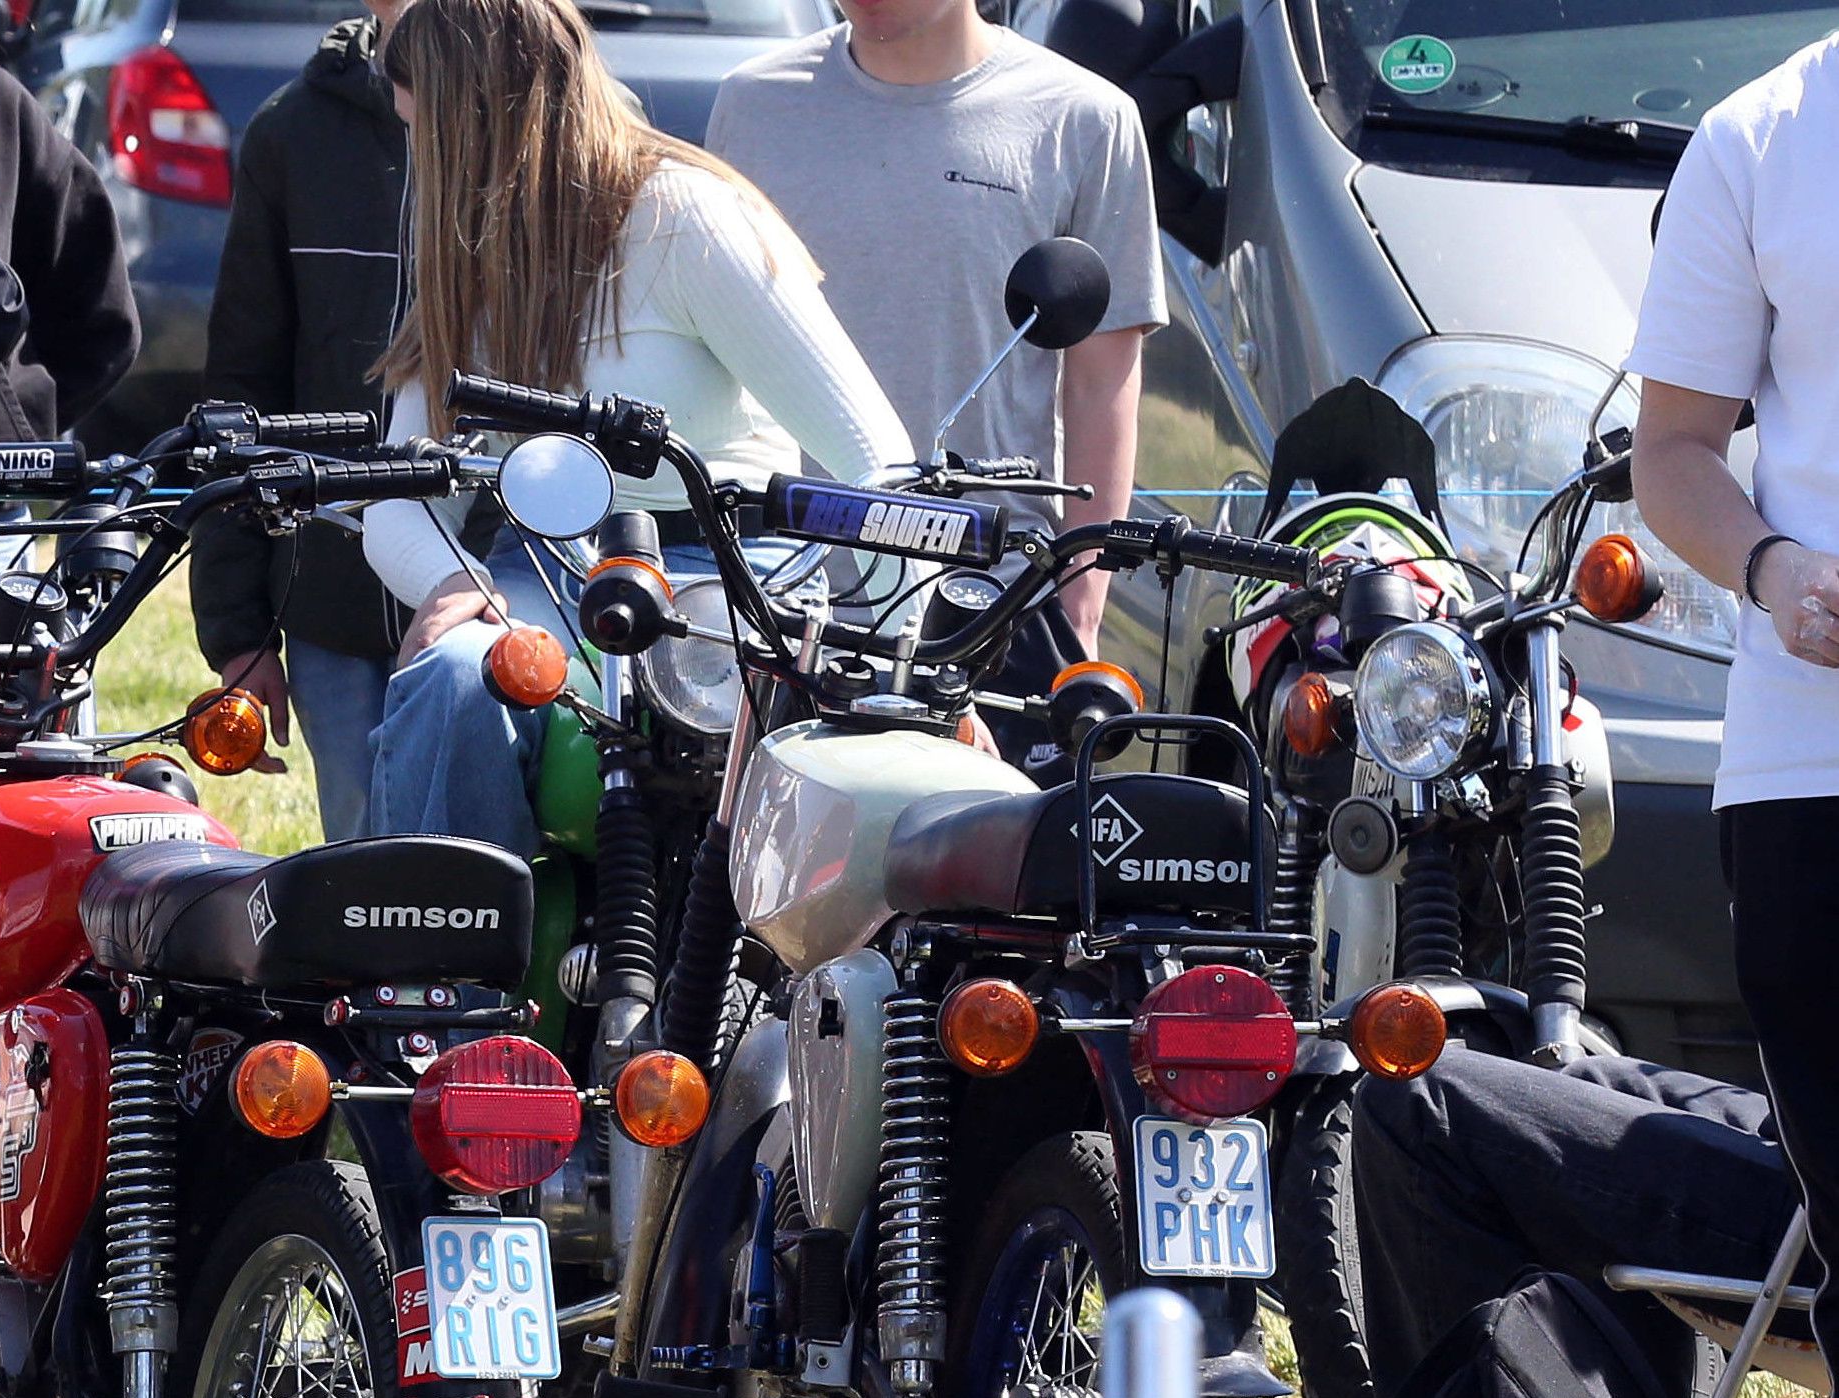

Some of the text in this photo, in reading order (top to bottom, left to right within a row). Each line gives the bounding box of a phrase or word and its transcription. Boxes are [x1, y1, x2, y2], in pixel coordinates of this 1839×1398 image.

[859, 502, 970, 555] SAUFEN
[1091, 818, 1124, 842] IFA
[343, 905, 500, 929] simson
[1152, 1129, 1254, 1191] 932
[436, 1230, 533, 1293] 896
[1154, 1202, 1258, 1266] PHK
[447, 1305, 541, 1366] RIG
